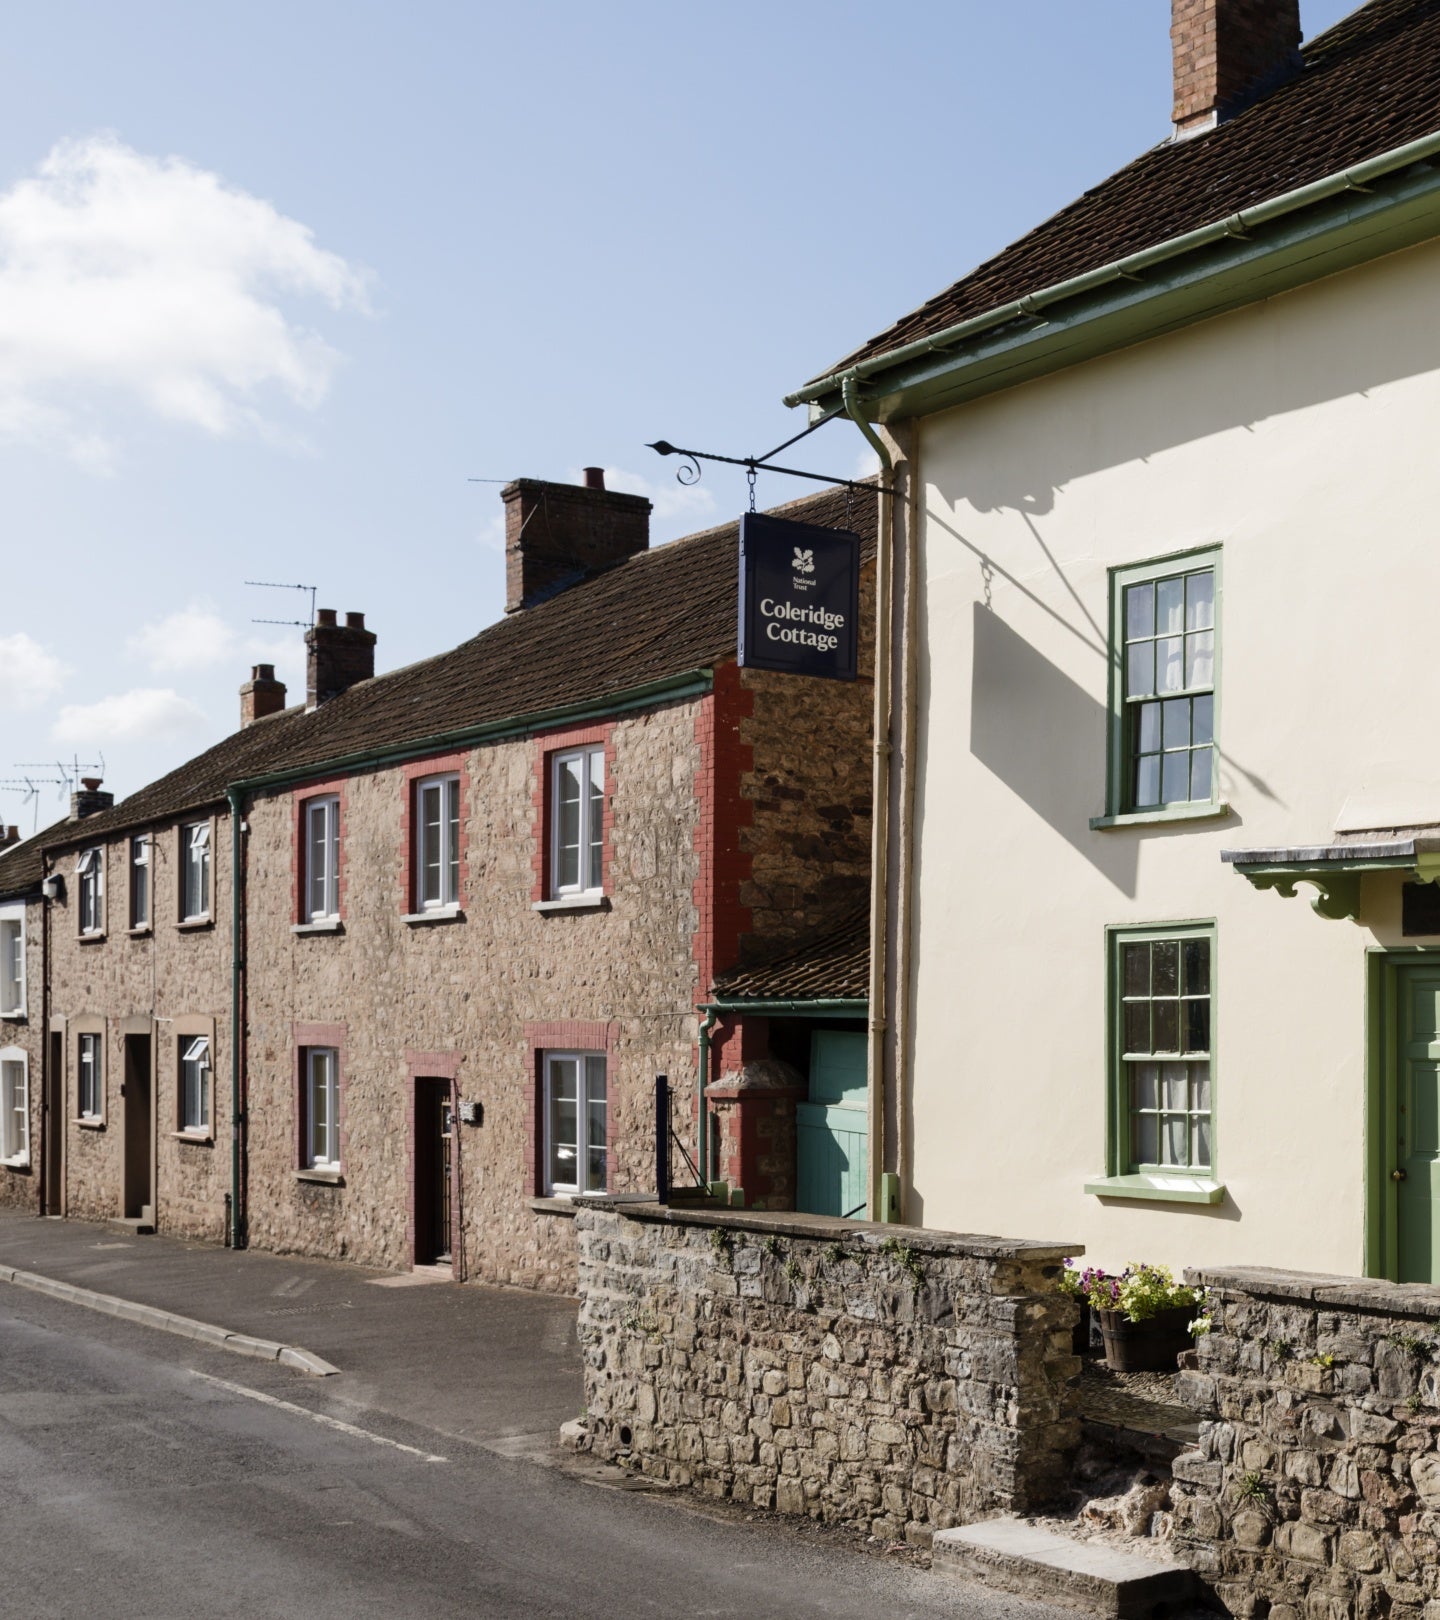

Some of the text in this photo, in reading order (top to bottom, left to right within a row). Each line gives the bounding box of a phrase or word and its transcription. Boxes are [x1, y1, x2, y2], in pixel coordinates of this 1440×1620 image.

[793, 576, 817, 586] National
[793, 583, 808, 591] Trust
[760, 598, 845, 631] Coleridge
[766, 622, 838, 652] Cottage
